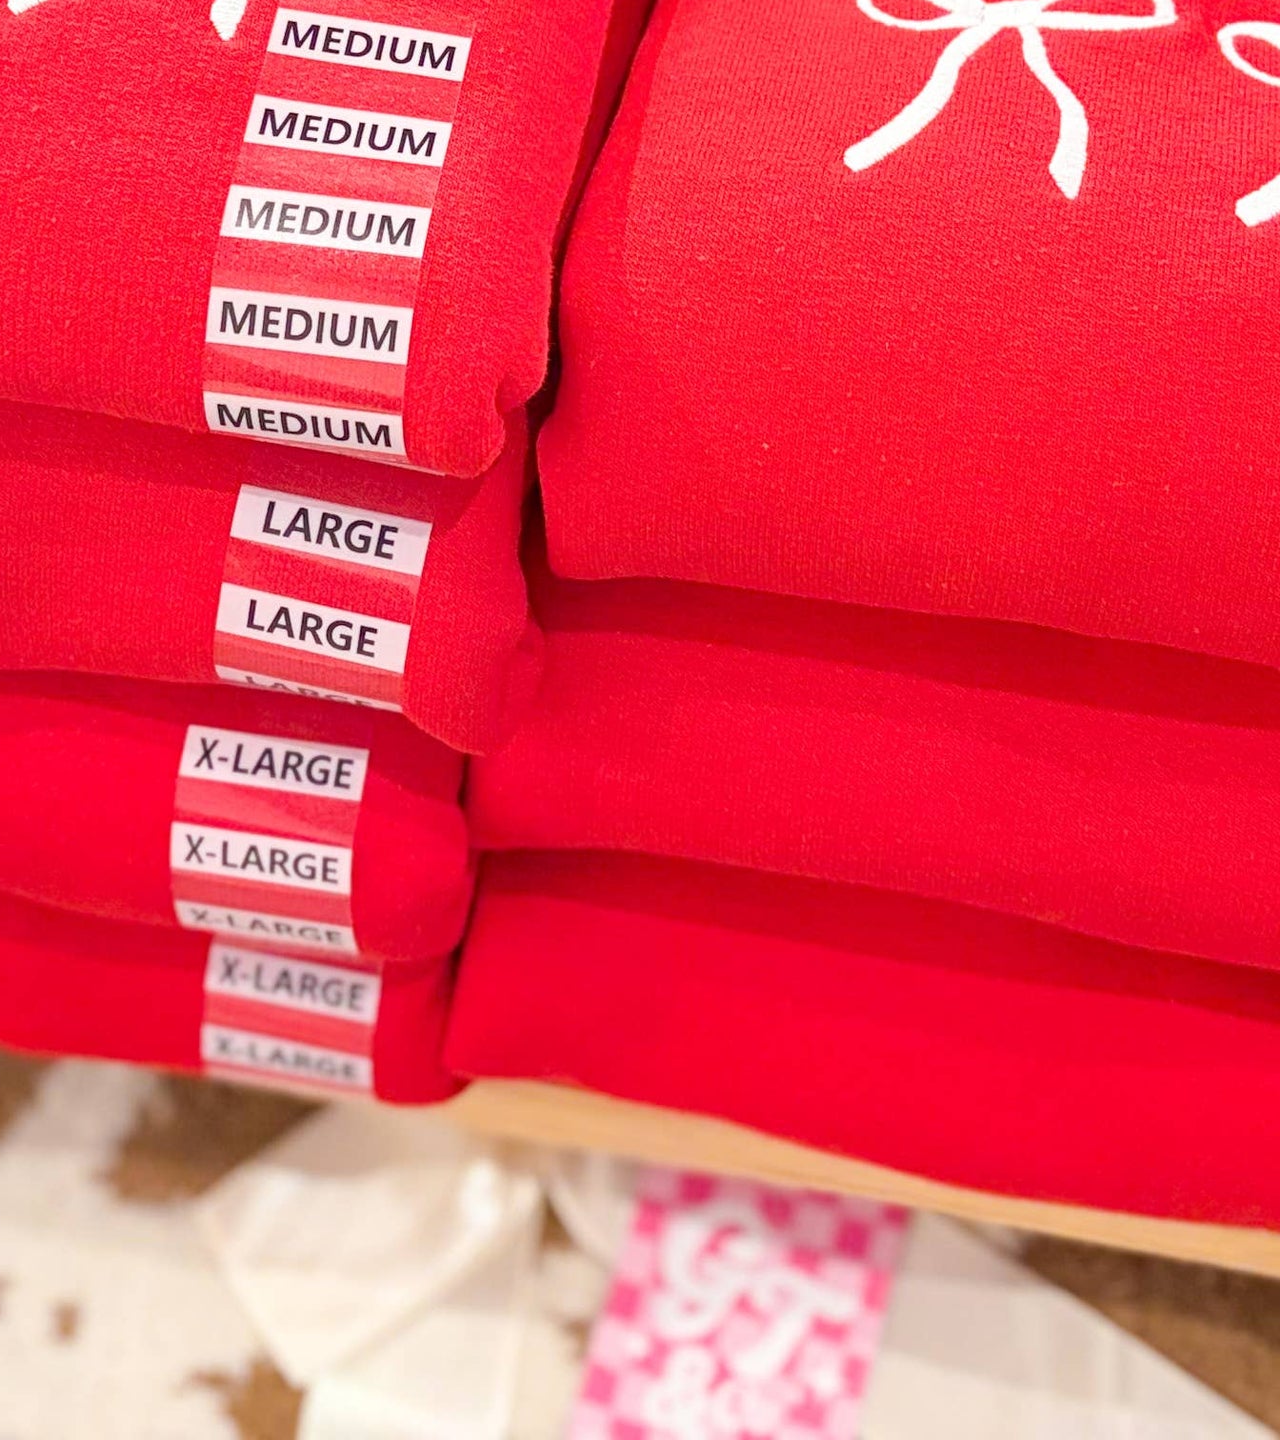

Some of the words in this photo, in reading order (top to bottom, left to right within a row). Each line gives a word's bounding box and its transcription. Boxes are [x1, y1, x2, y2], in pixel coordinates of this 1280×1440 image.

[282, 21, 456, 71] MEDIUM
[259, 108, 436, 157] MEDIUM
[235, 198, 416, 247] MEDIUM
[219, 301, 399, 352] MEDIUM
[216, 404, 392, 447] MEDIUM
[262, 500, 399, 560] LARGE
[246, 599, 378, 657] LARGE
[195, 737, 354, 789] X-LARGE
[185, 834, 339, 884] X-LARGE
[190, 907, 344, 944] X-LARGE
[220, 956, 366, 1010] X-LARGE
[215, 1036, 359, 1081] X-LARGE
